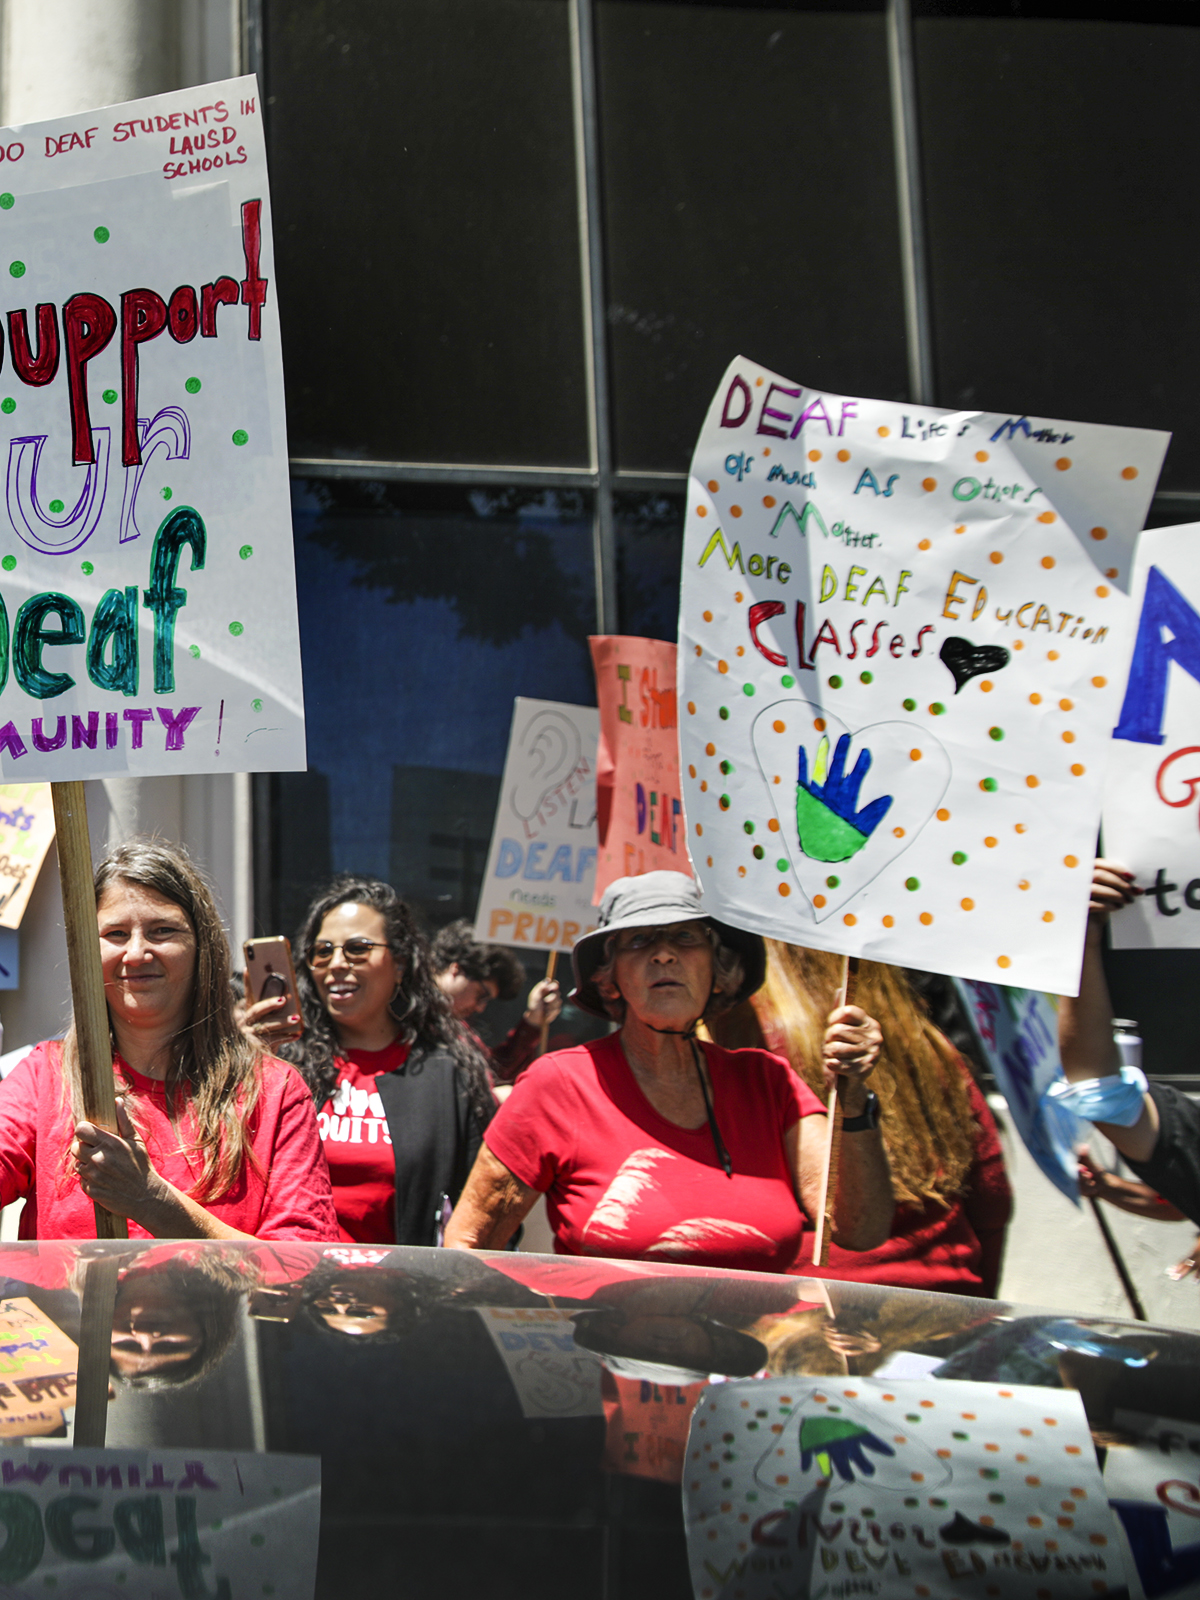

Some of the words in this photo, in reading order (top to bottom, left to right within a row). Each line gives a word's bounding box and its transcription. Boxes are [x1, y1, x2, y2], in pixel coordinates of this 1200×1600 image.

[44, 126, 99, 158] DEAF
[112, 100, 230, 142] STUDENTS
[240, 97, 256, 116] IN
[168, 126, 237, 155] LAUSD
[162, 145, 248, 179] SCHOOLS
[719, 372, 859, 440] DEAF
[818, 563, 913, 608] DEAF
[521, 755, 593, 840] LISTEN
[494, 836, 597, 883] DEAF
[487, 908, 599, 947] PRIOR
[316, 1112, 393, 1145] QUIT
